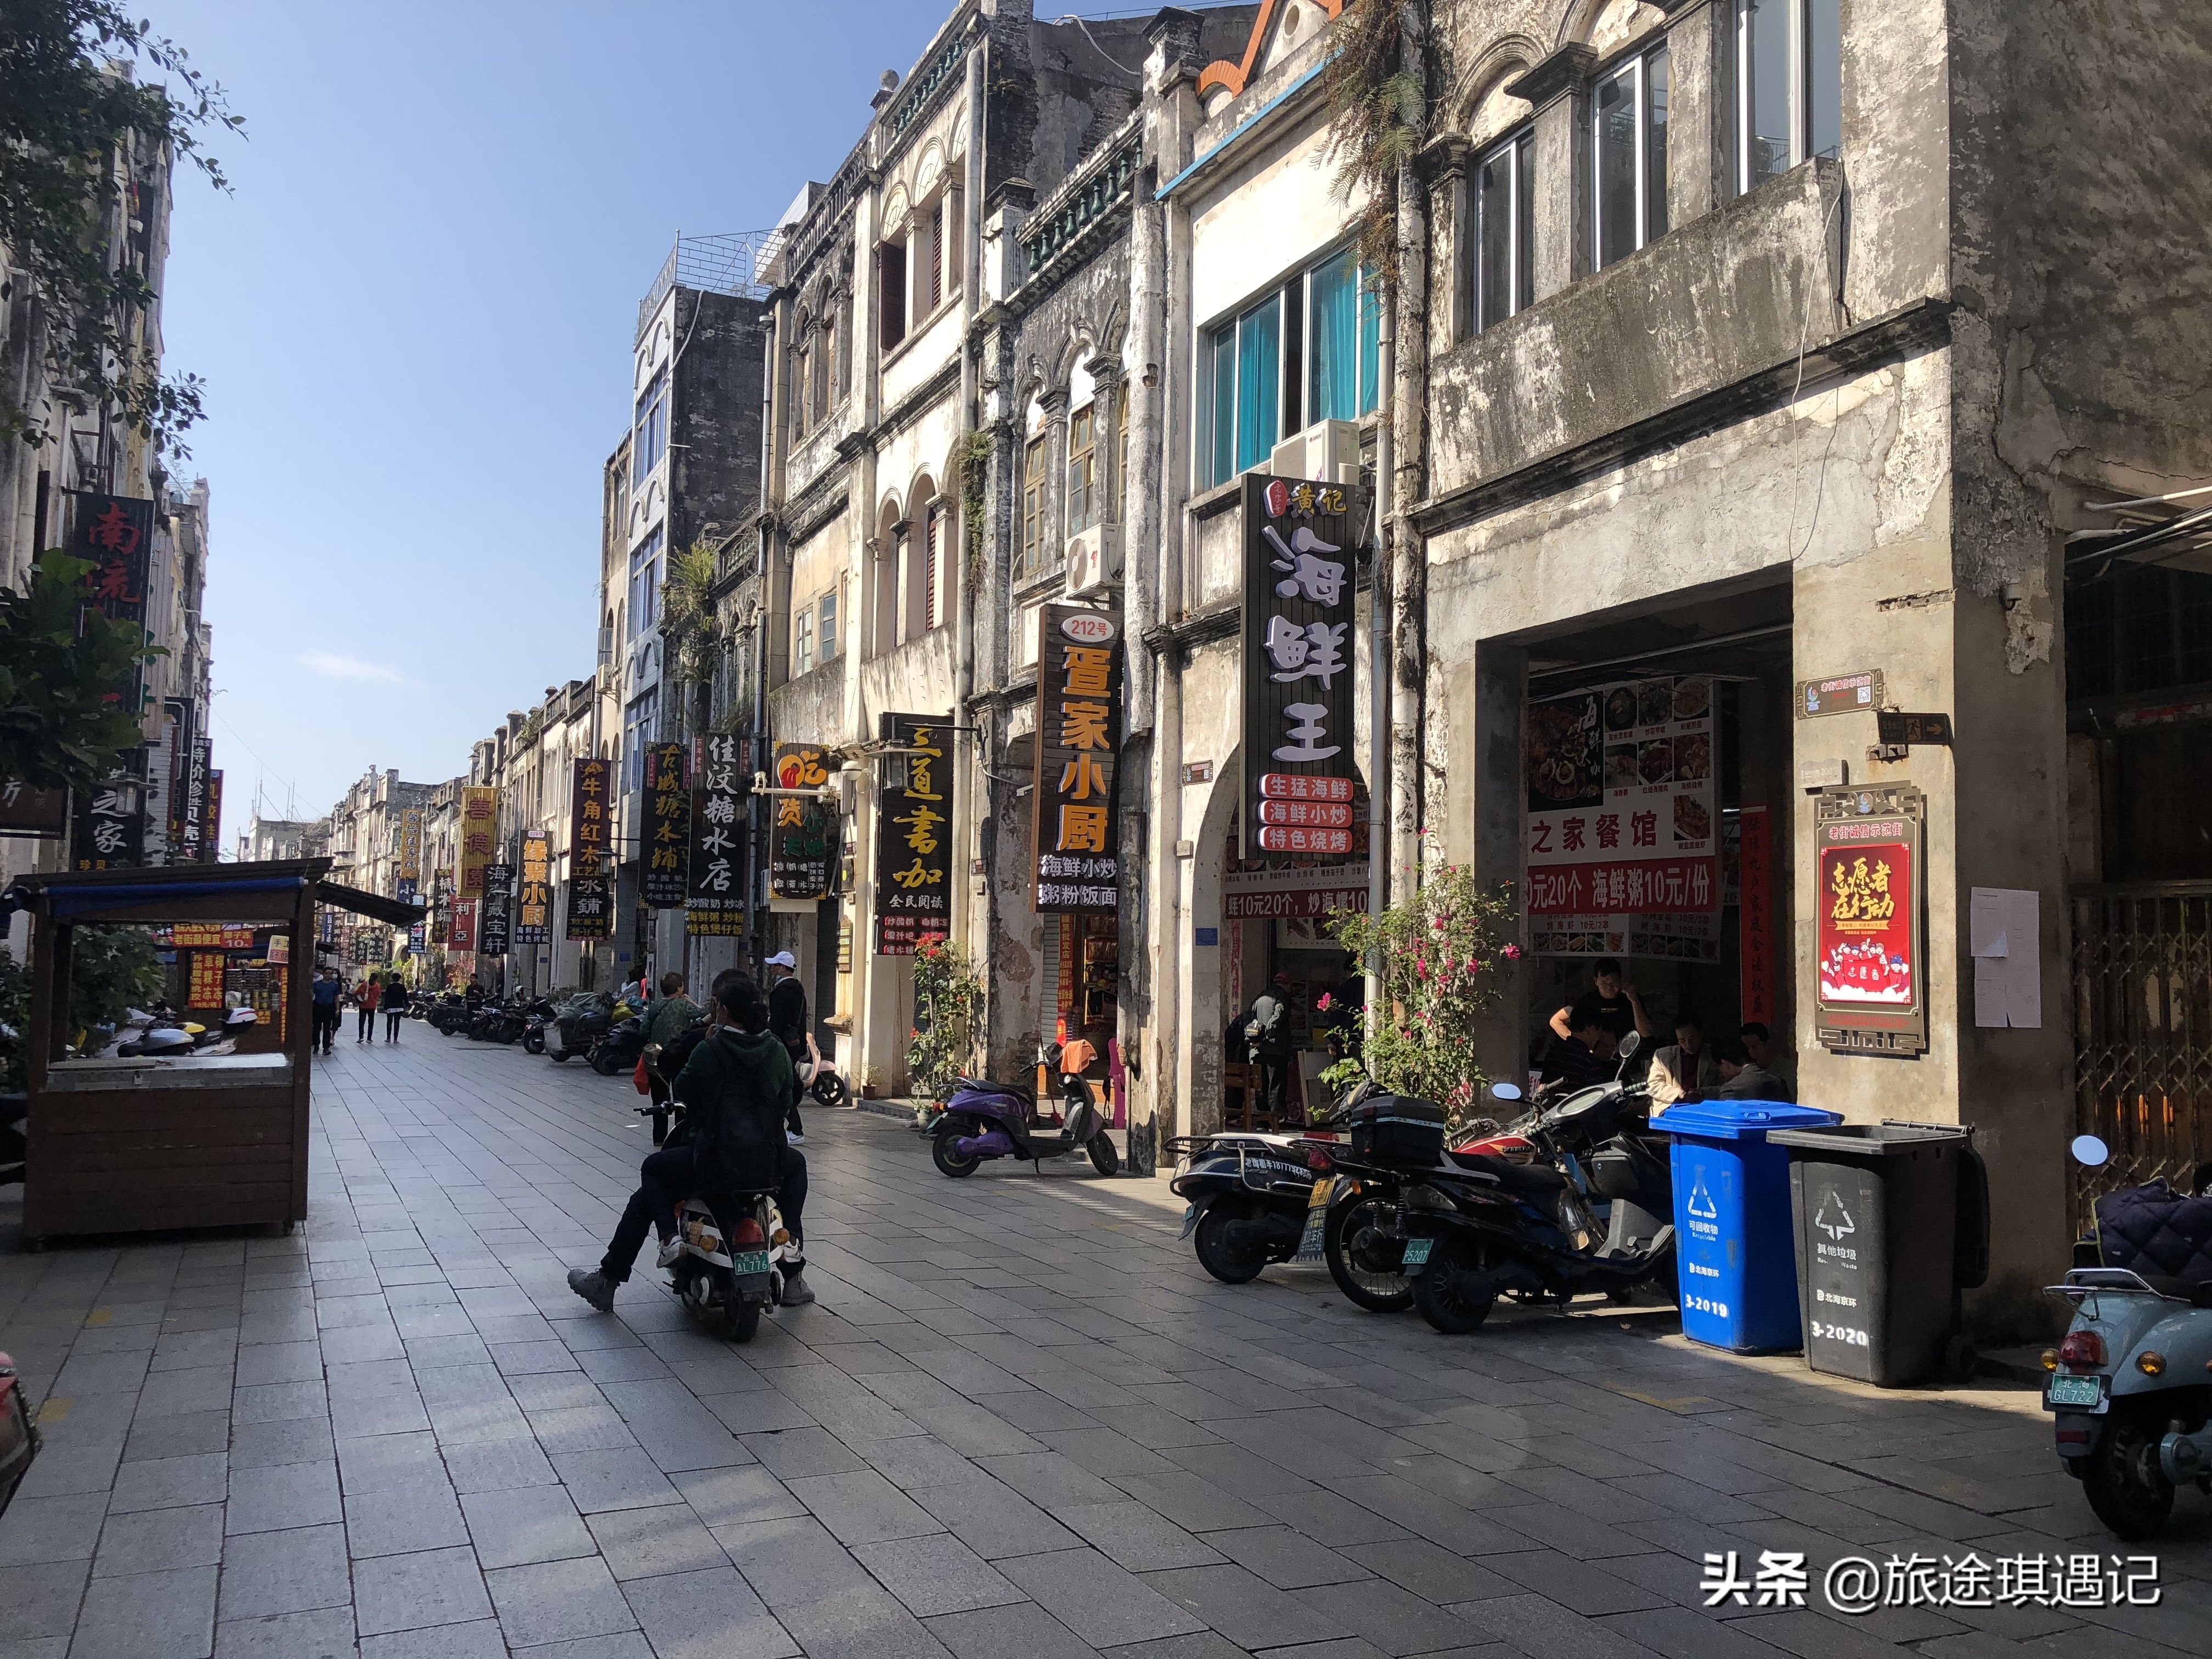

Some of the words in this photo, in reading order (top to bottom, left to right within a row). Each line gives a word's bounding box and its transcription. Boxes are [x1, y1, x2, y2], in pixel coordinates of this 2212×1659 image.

[1273, 484, 1283, 515] 老字号
[1291, 483, 1347, 516] 黄记
[1071, 619, 1108, 637] 212号
[1262, 526, 1347, 762] 海鲜王
[1821, 675, 1871, 693] 老街诚信示范街
[1270, 776, 1348, 799] 生猛海鲜
[580, 777, 602, 864] 牛角红木
[699, 735, 738, 891] 佳汶糖水店
[1270, 803, 1347, 825] 海鲜小炒
[1269, 828, 1347, 851] 特色烧烤
[1531, 809, 1657, 853] 之家餐馆
[1829, 822, 1903, 840] 老街诚信示范街
[1041, 854, 1118, 878] 海鲜小炒
[1831, 857, 1892, 895] 志愿者
[521, 840, 548, 927] 缘聚小厨
[1038, 883, 1118, 906] 粥粉饭面
[1592, 864, 1709, 909] 海鲜粥10元/份
[685, 898, 720, 909] 炒酸奶
[724, 899, 744, 910] 炒冰
[889, 894, 944, 910] 全民阅读
[1831, 893, 1895, 920] 在行动
[688, 911, 720, 922] 海鲜粥
[723, 912, 744, 923] 炒粉
[174, 934, 221, 945] 老街最便宜
[516, 926, 549, 934] 海鲜加工
[687, 923, 743, 936] 特色煲仔饭
[1061, 914, 1070, 960] 腰果批发店
[1689, 1220, 1718, 1235] 可回收物
[1403, 1250, 1428, 1262] P5207
[1817, 1243, 1857, 1261] 其他垃圾
[737, 1260, 768, 1273] AL776
[1695, 1265, 1720, 1278] 北海京环
[1685, 1293, 1729, 1318] 3-2019
[1825, 1293, 1858, 1308] 北海京环
[1812, 1321, 1869, 1347] 3-2020
[2062, 1379, 2090, 1390] 北海
[2053, 1389, 2094, 1403] GL722
